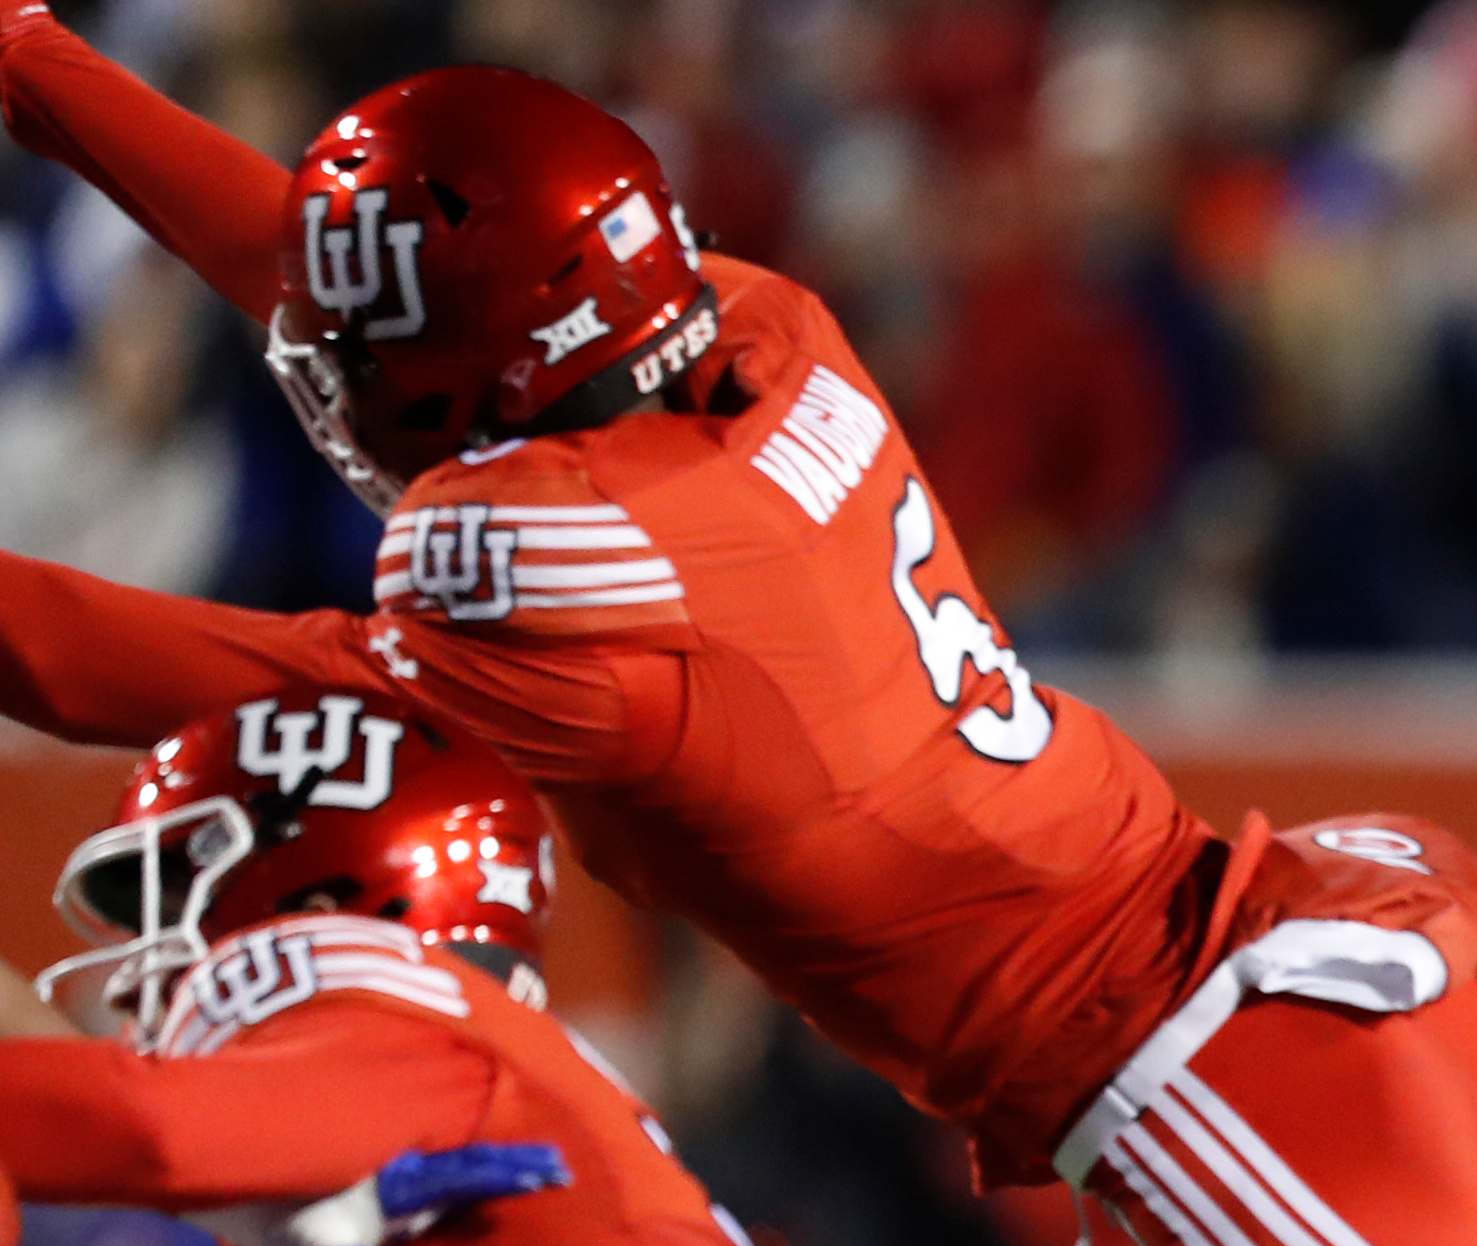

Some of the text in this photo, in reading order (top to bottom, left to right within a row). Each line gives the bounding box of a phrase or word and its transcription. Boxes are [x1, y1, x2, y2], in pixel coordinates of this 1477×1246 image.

[630, 308, 718, 395] UTES
[749, 363, 890, 527] VAUGHN
[891, 473, 1055, 764] 5
